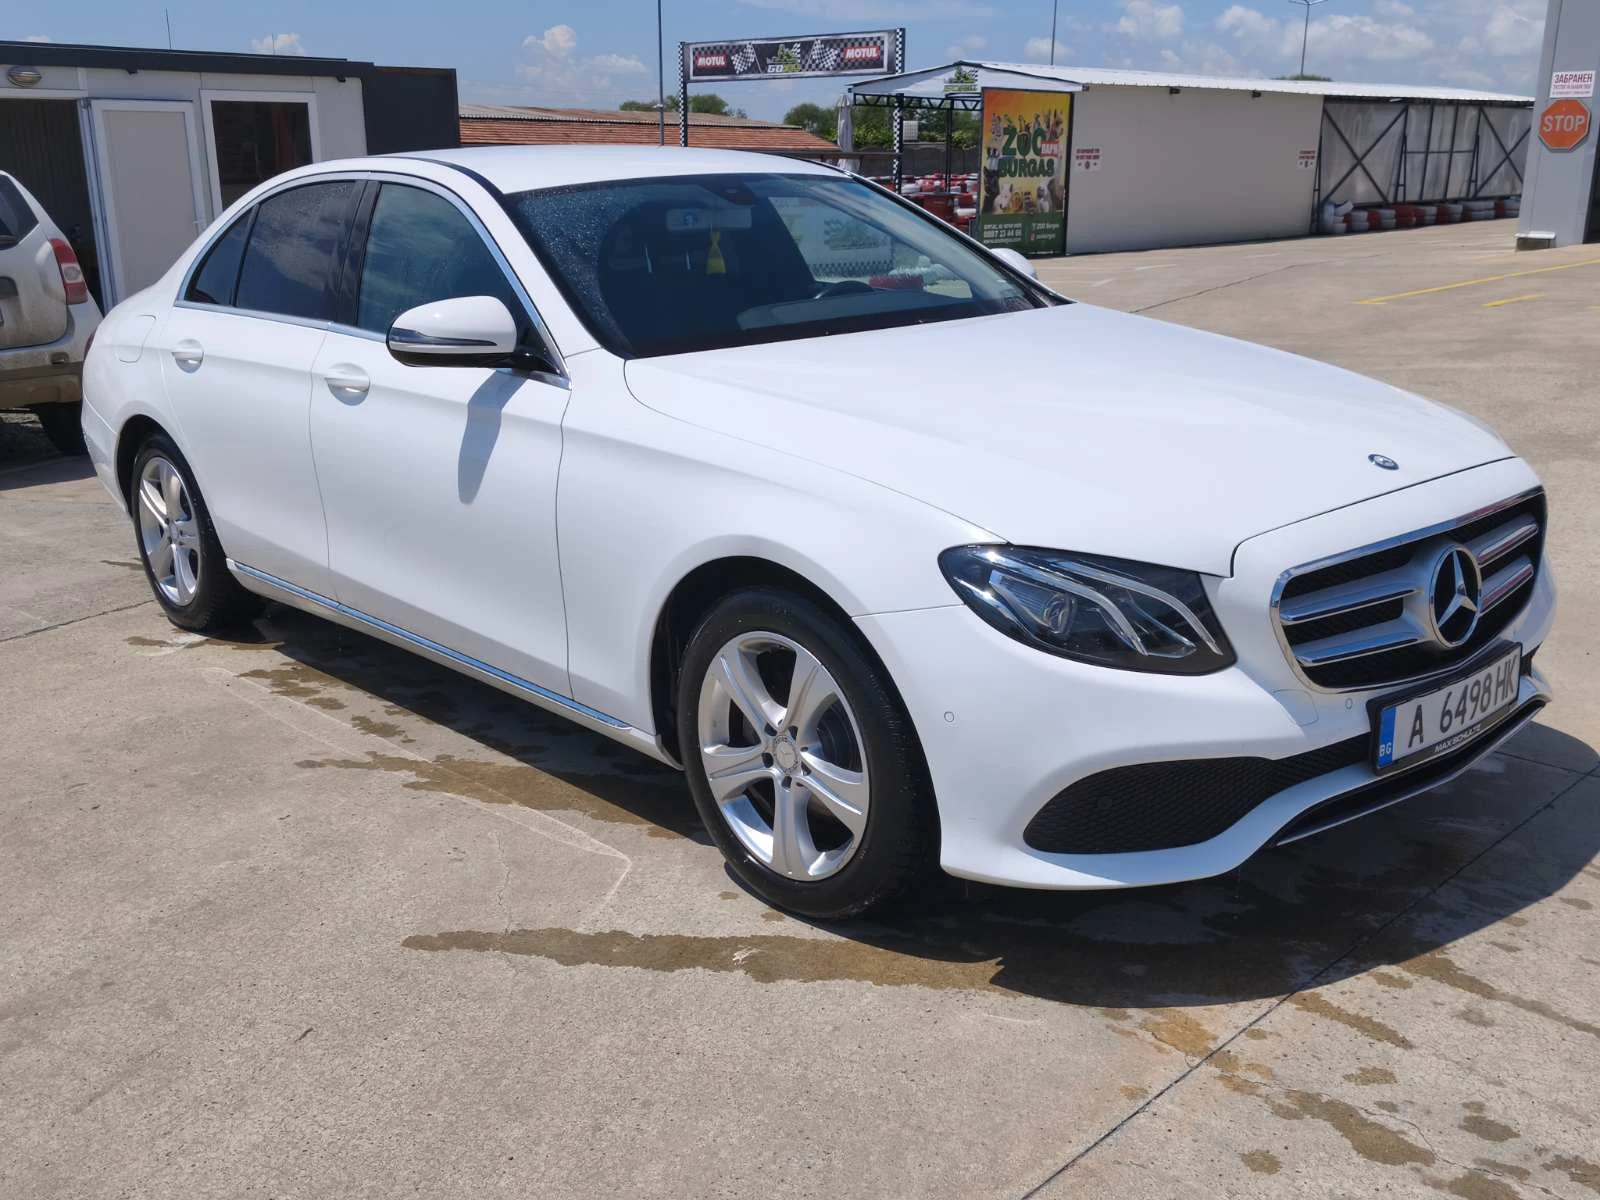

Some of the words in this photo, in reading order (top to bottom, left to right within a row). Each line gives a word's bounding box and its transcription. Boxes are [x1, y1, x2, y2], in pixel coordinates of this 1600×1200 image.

[846, 47, 877, 58] MOTUL
[698, 56, 725, 67] MOTUL
[1555, 73, 1592, 83] ЗАБРАНЕН
[1543, 115, 1585, 132] STOP
[999, 158, 1055, 178] BURGAS
[1408, 704, 1424, 748] A
[1440, 672, 1492, 734] 6498
[1494, 654, 1518, 706] HK
[1379, 742, 1392, 758] BG
